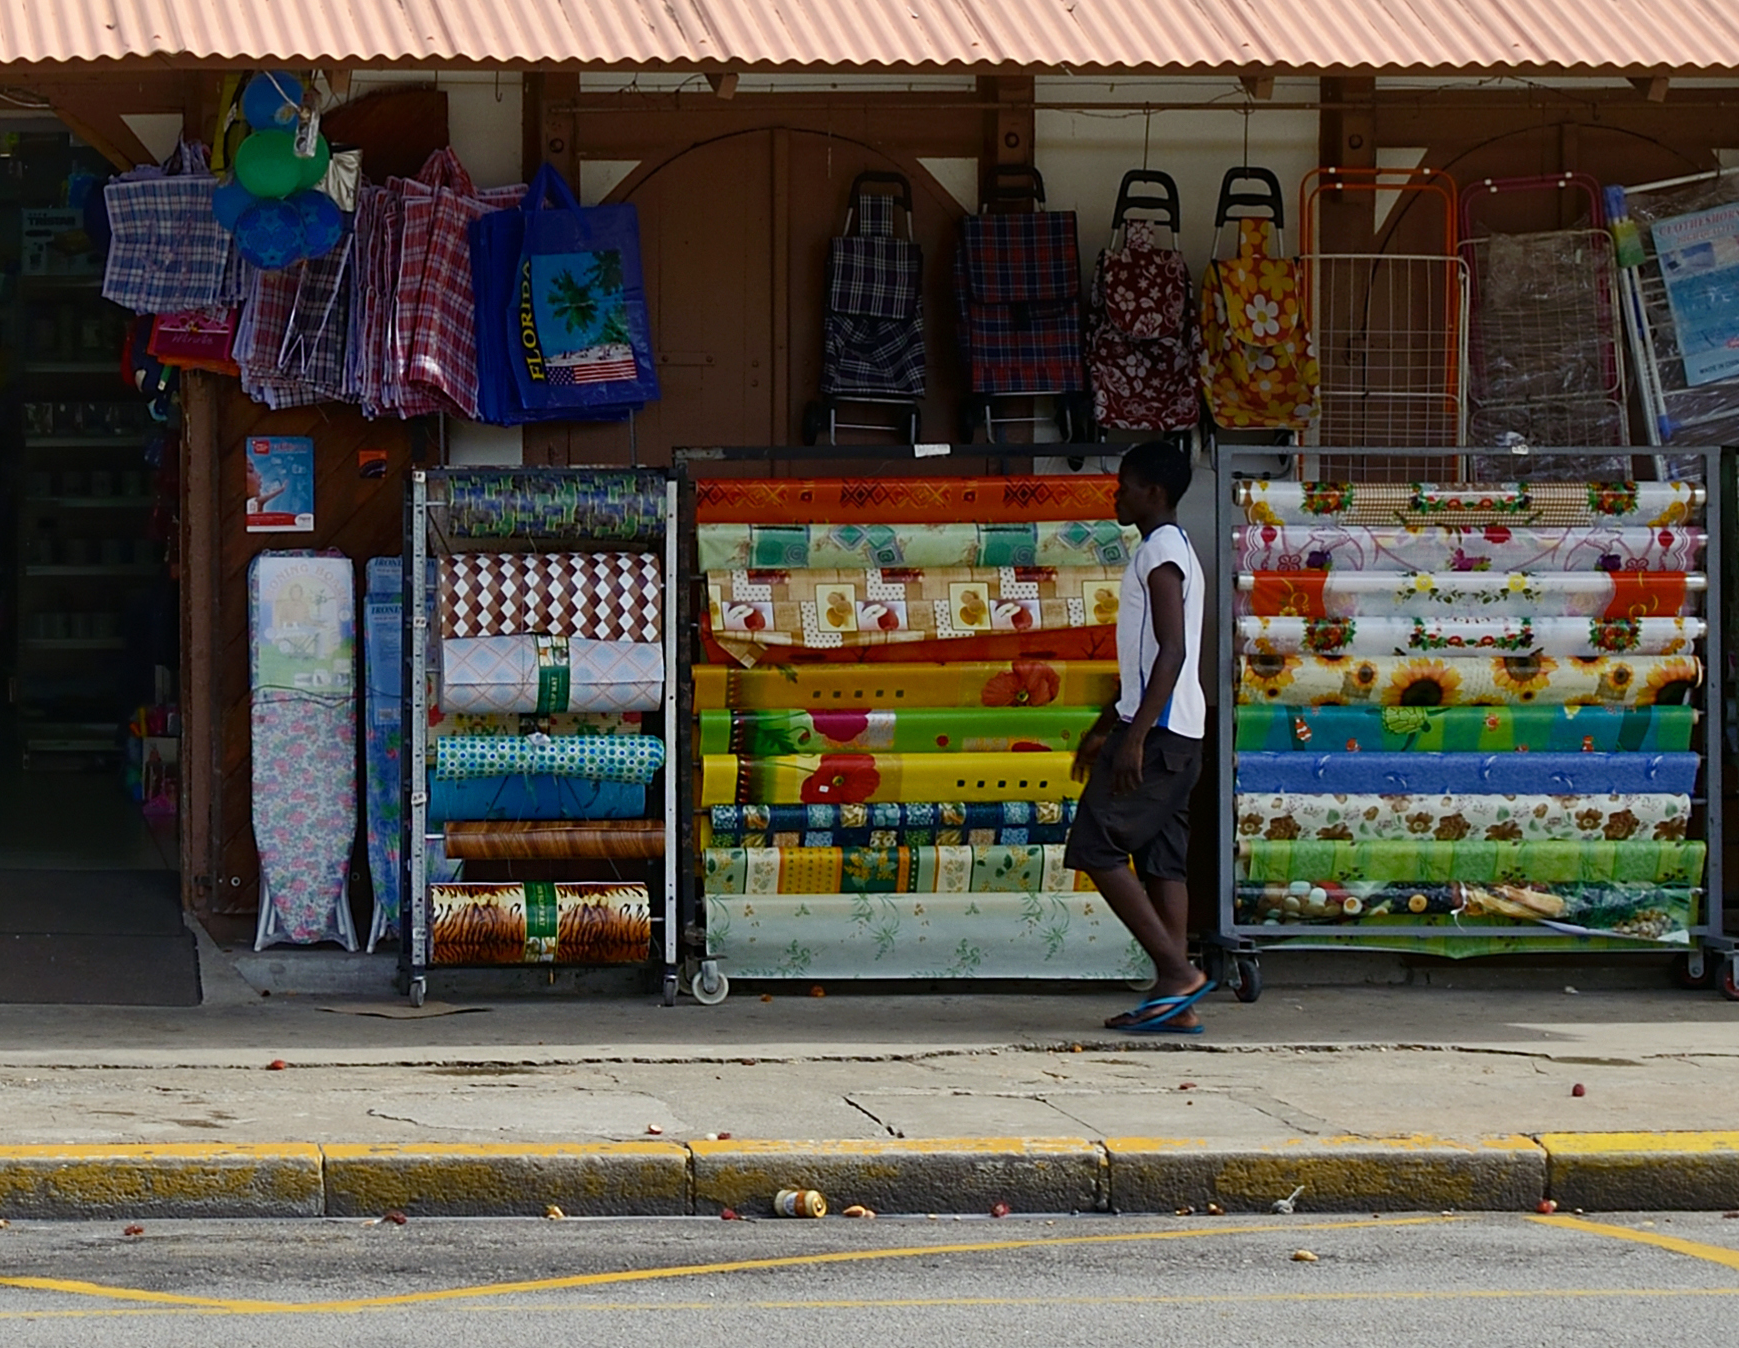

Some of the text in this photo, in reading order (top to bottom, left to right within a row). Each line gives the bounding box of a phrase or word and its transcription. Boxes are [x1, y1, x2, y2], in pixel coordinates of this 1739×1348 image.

[27, 216, 76, 226] TRISTAR
[521, 260, 545, 381] FLORIDA
[1699, 364, 1717, 375] MADE
